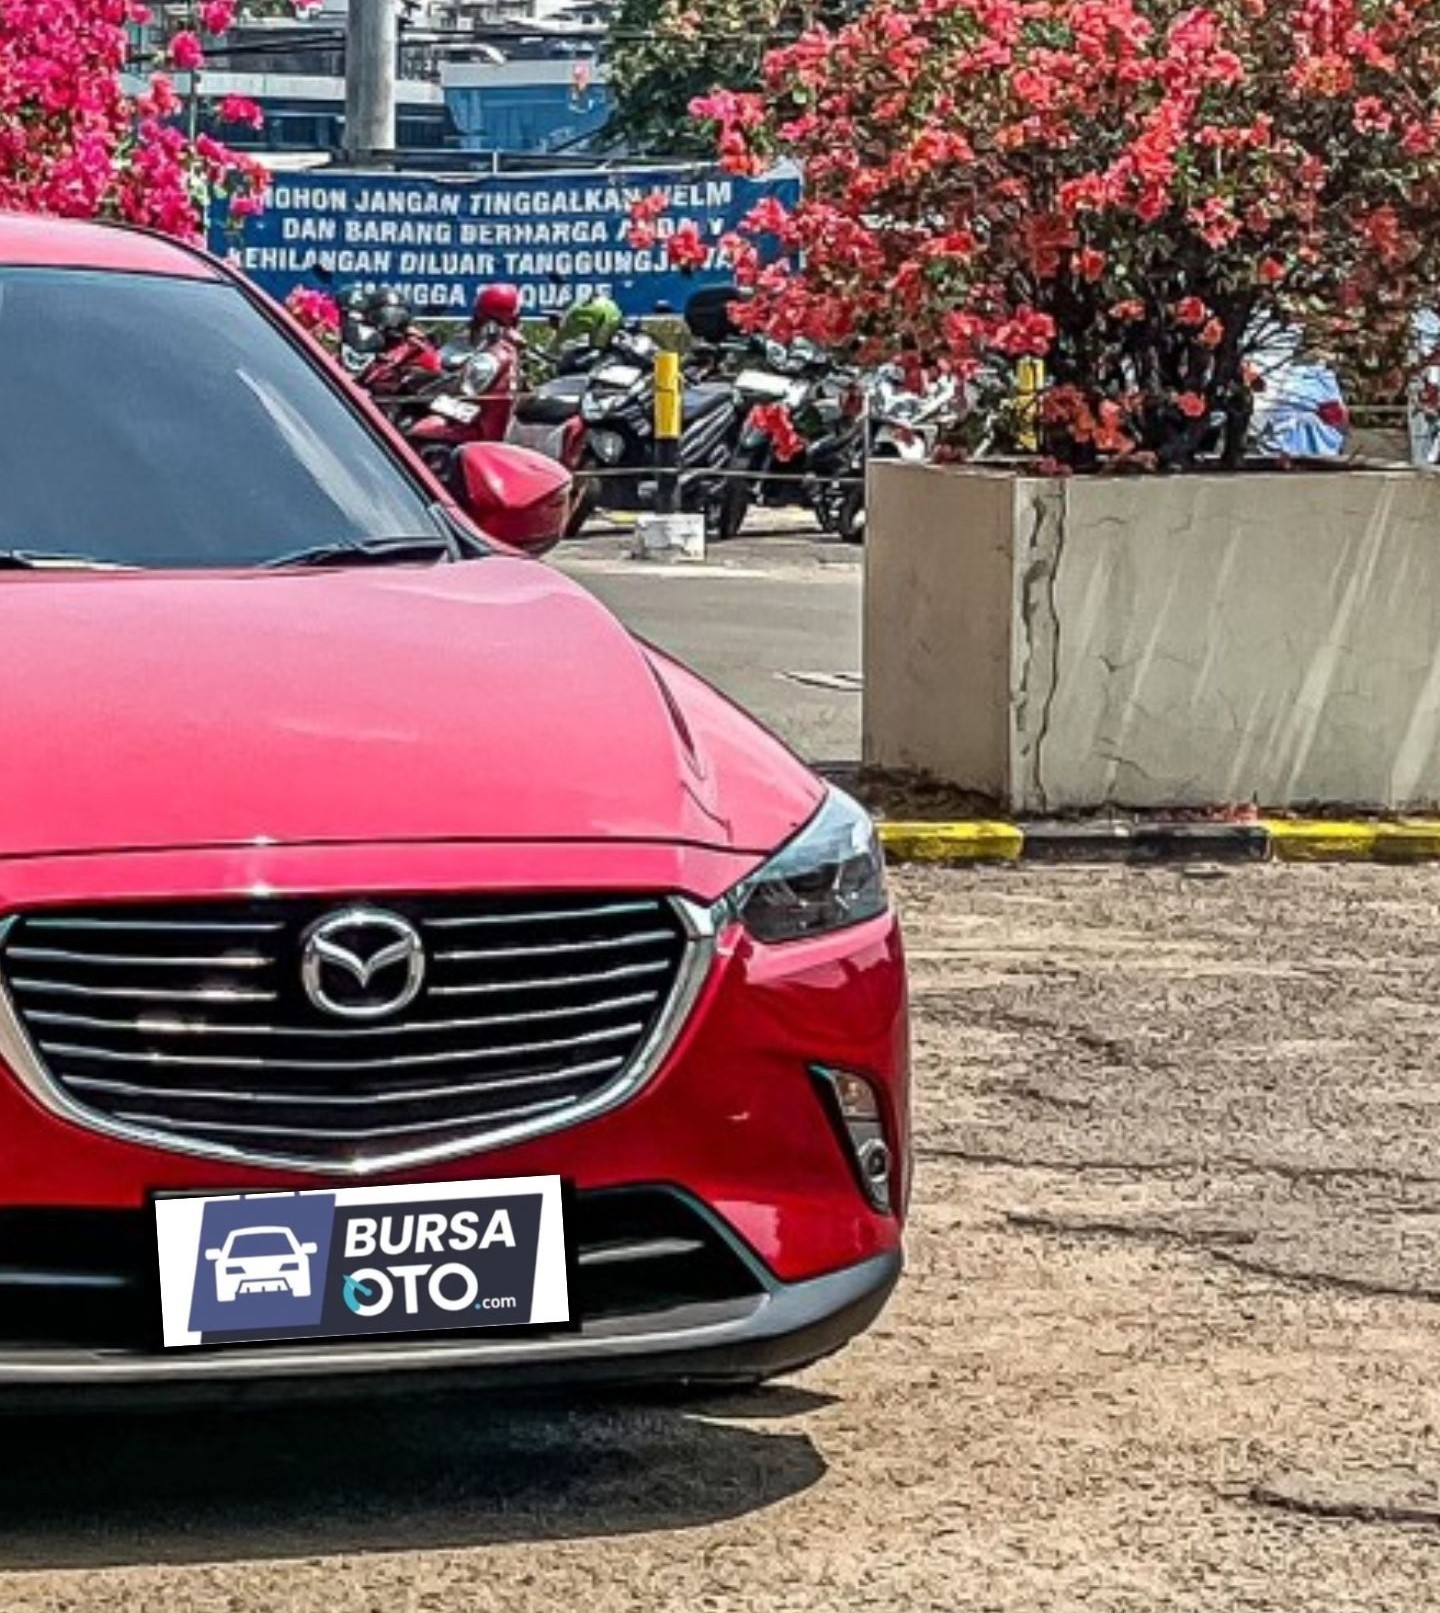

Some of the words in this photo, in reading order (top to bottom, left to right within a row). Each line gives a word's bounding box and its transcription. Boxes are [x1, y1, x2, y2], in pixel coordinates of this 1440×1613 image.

[355, 188, 459, 214] JANGAN
[282, 217, 336, 240] DAN
[344, 220, 452, 245] BARANG
[460, 220, 608, 245] BERHARGA
[399, 251, 495, 276] DILUAR
